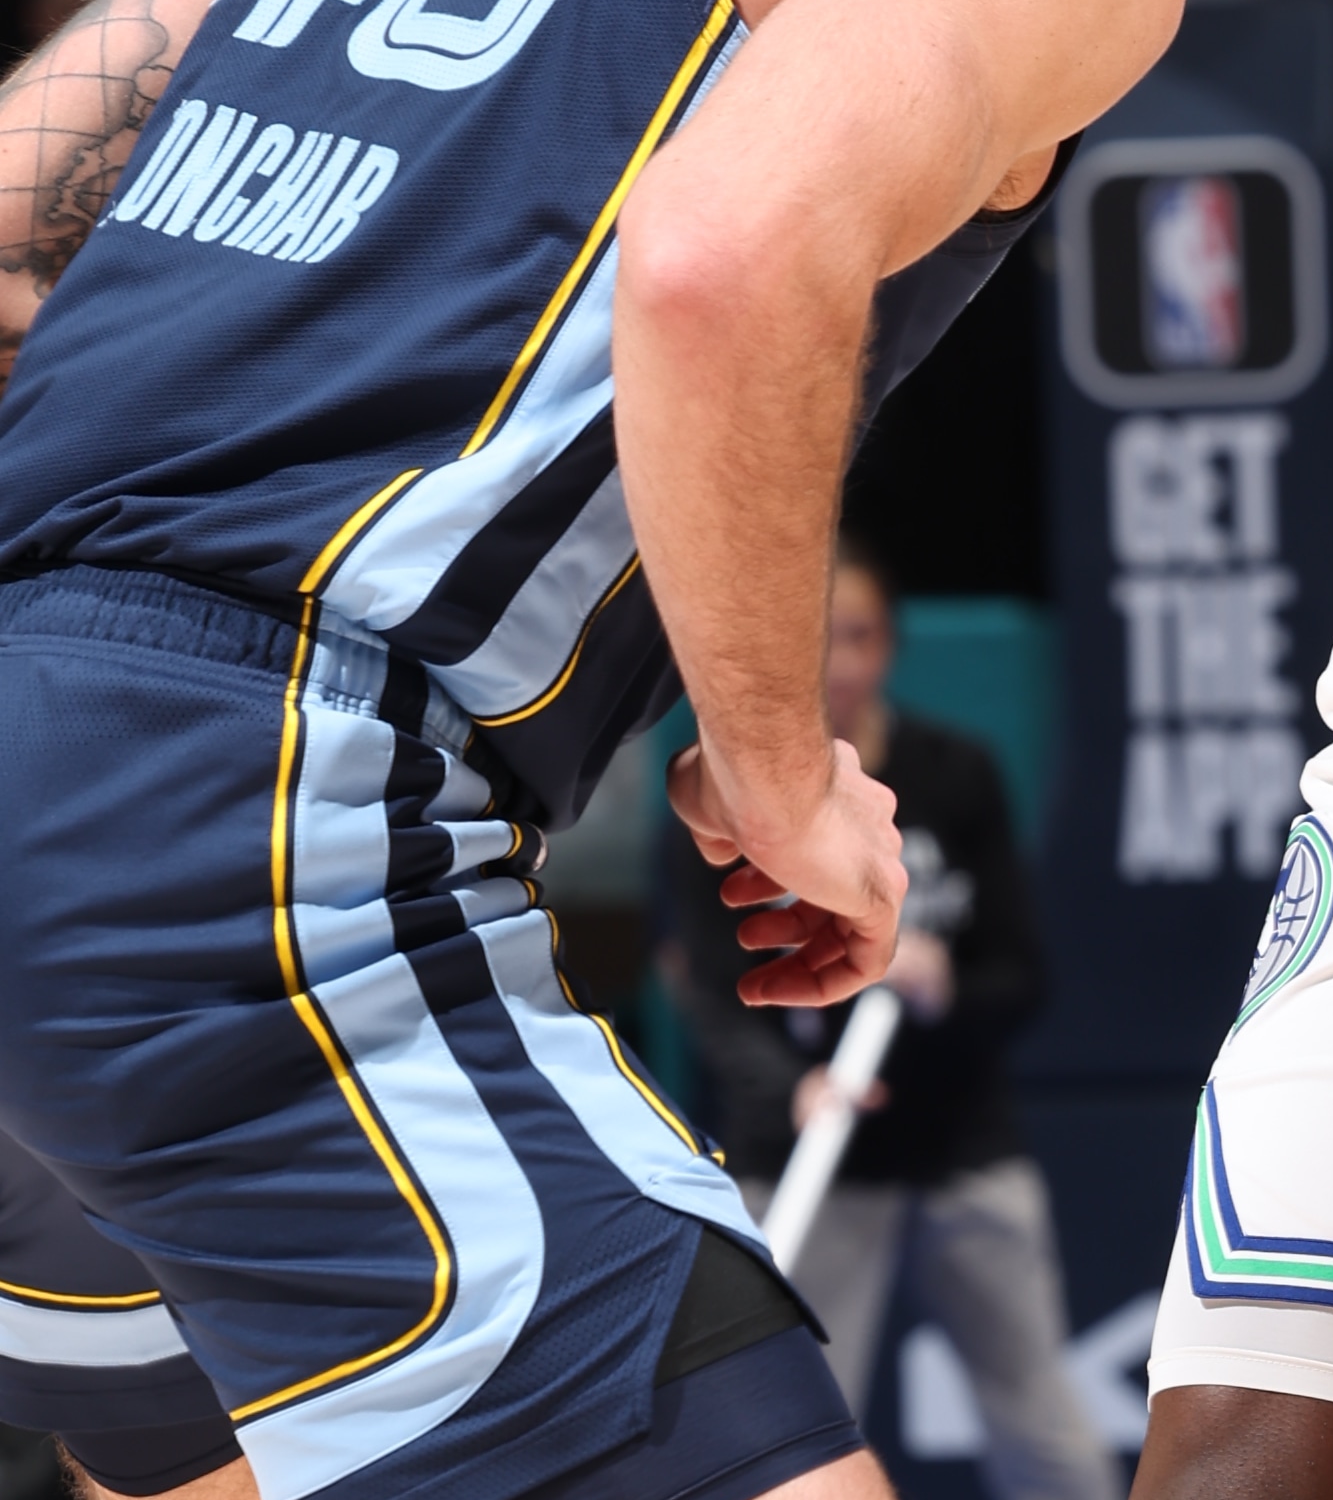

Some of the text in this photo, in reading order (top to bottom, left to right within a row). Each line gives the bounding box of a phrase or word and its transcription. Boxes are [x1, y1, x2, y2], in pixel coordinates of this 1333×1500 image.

[97, 98, 399, 264] ONCHAR
[1109, 413, 1289, 568] GET
[1113, 575, 1296, 719] THE
[1117, 728, 1307, 884] APP
